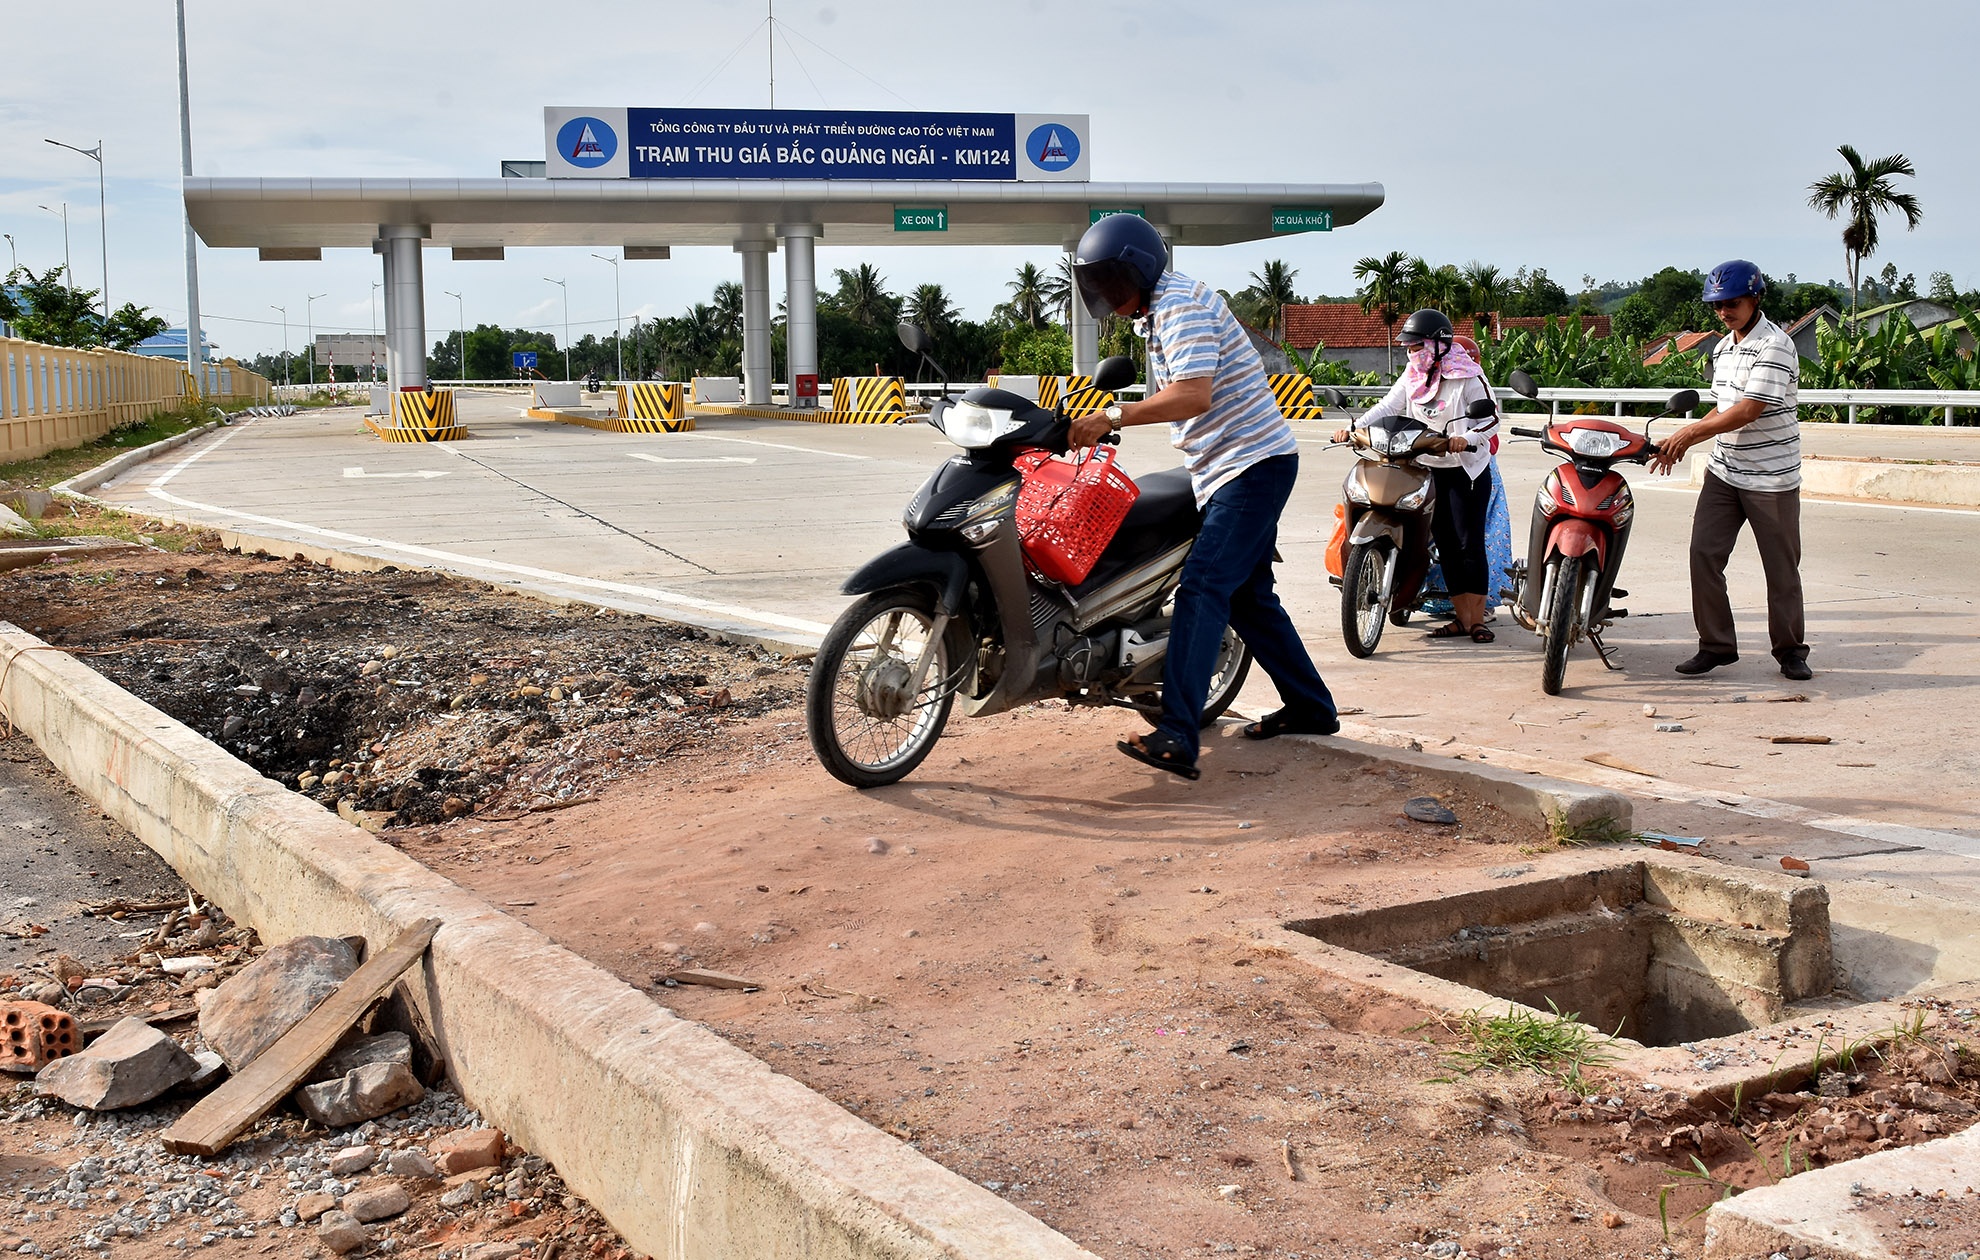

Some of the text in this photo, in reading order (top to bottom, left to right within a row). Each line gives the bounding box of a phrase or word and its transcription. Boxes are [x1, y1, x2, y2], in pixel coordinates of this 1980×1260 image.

[650, 119, 995, 138] TỔNG CÔNG TY ĐẦU TƯ VÀ PHÁT TRIỂN ĐƯỜNG CAO TỐC VIỆT NAM
[635, 146, 690, 166] TRẠM
[695, 146, 733, 163] THU
[738, 142, 771, 164] GIÁ
[777, 139, 815, 164] BẮC
[820, 141, 886, 165] QUẢNG
[891, 144, 935, 165] NGÃI
[955, 149, 1010, 165] KM124
[901, 215, 934, 225] XE CON
[1274, 216, 1285, 225] XE
[1286, 213, 1304, 225] QUÁ
